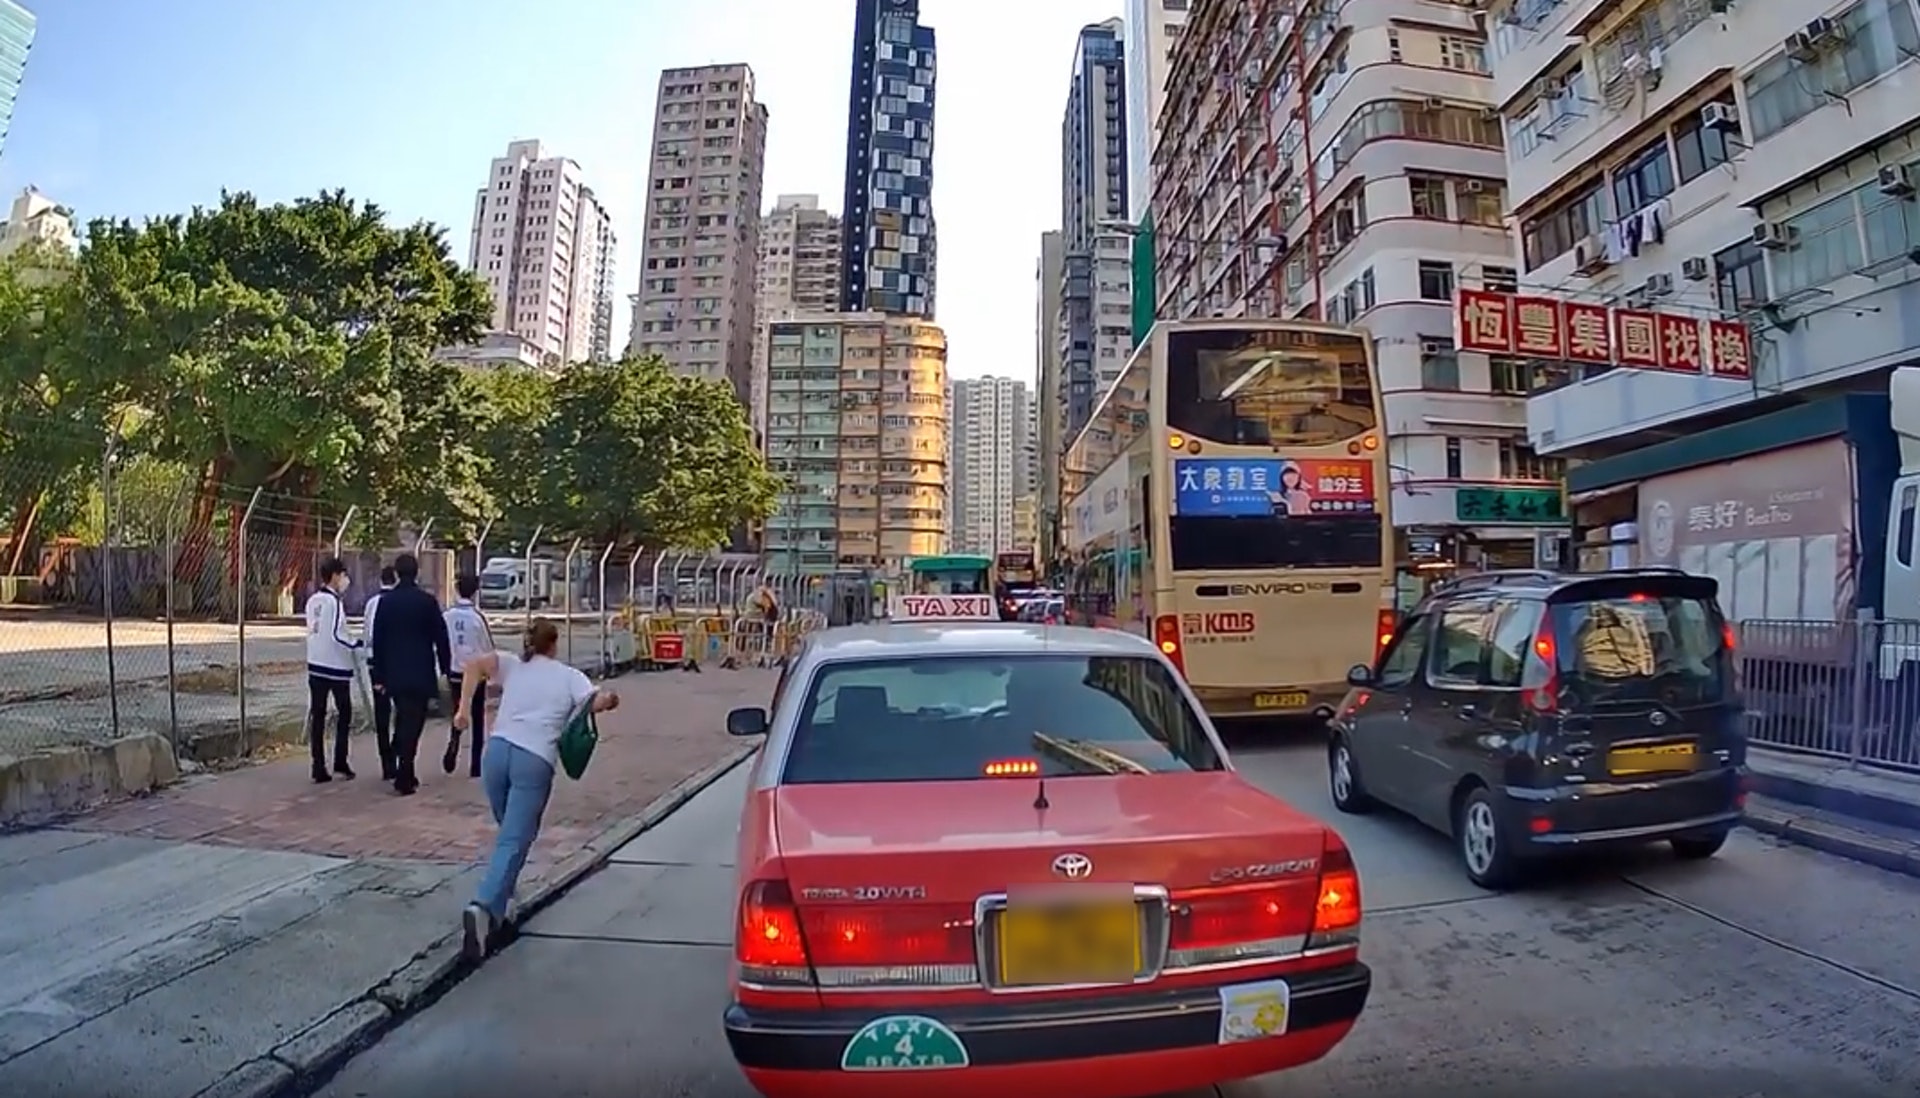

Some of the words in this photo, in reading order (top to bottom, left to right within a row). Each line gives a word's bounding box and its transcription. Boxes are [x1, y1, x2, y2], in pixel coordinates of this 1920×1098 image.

[1464, 296, 1748, 371] 恆豐集團找換
[1688, 500, 1738, 531] 泰好
[1231, 583, 1305, 595] ENVIRO
[903, 597, 991, 617] TAXI
[1206, 612, 1255, 634] KMB
[864, 1018, 935, 1042] TAXI
[894, 1033, 914, 1057] 4
